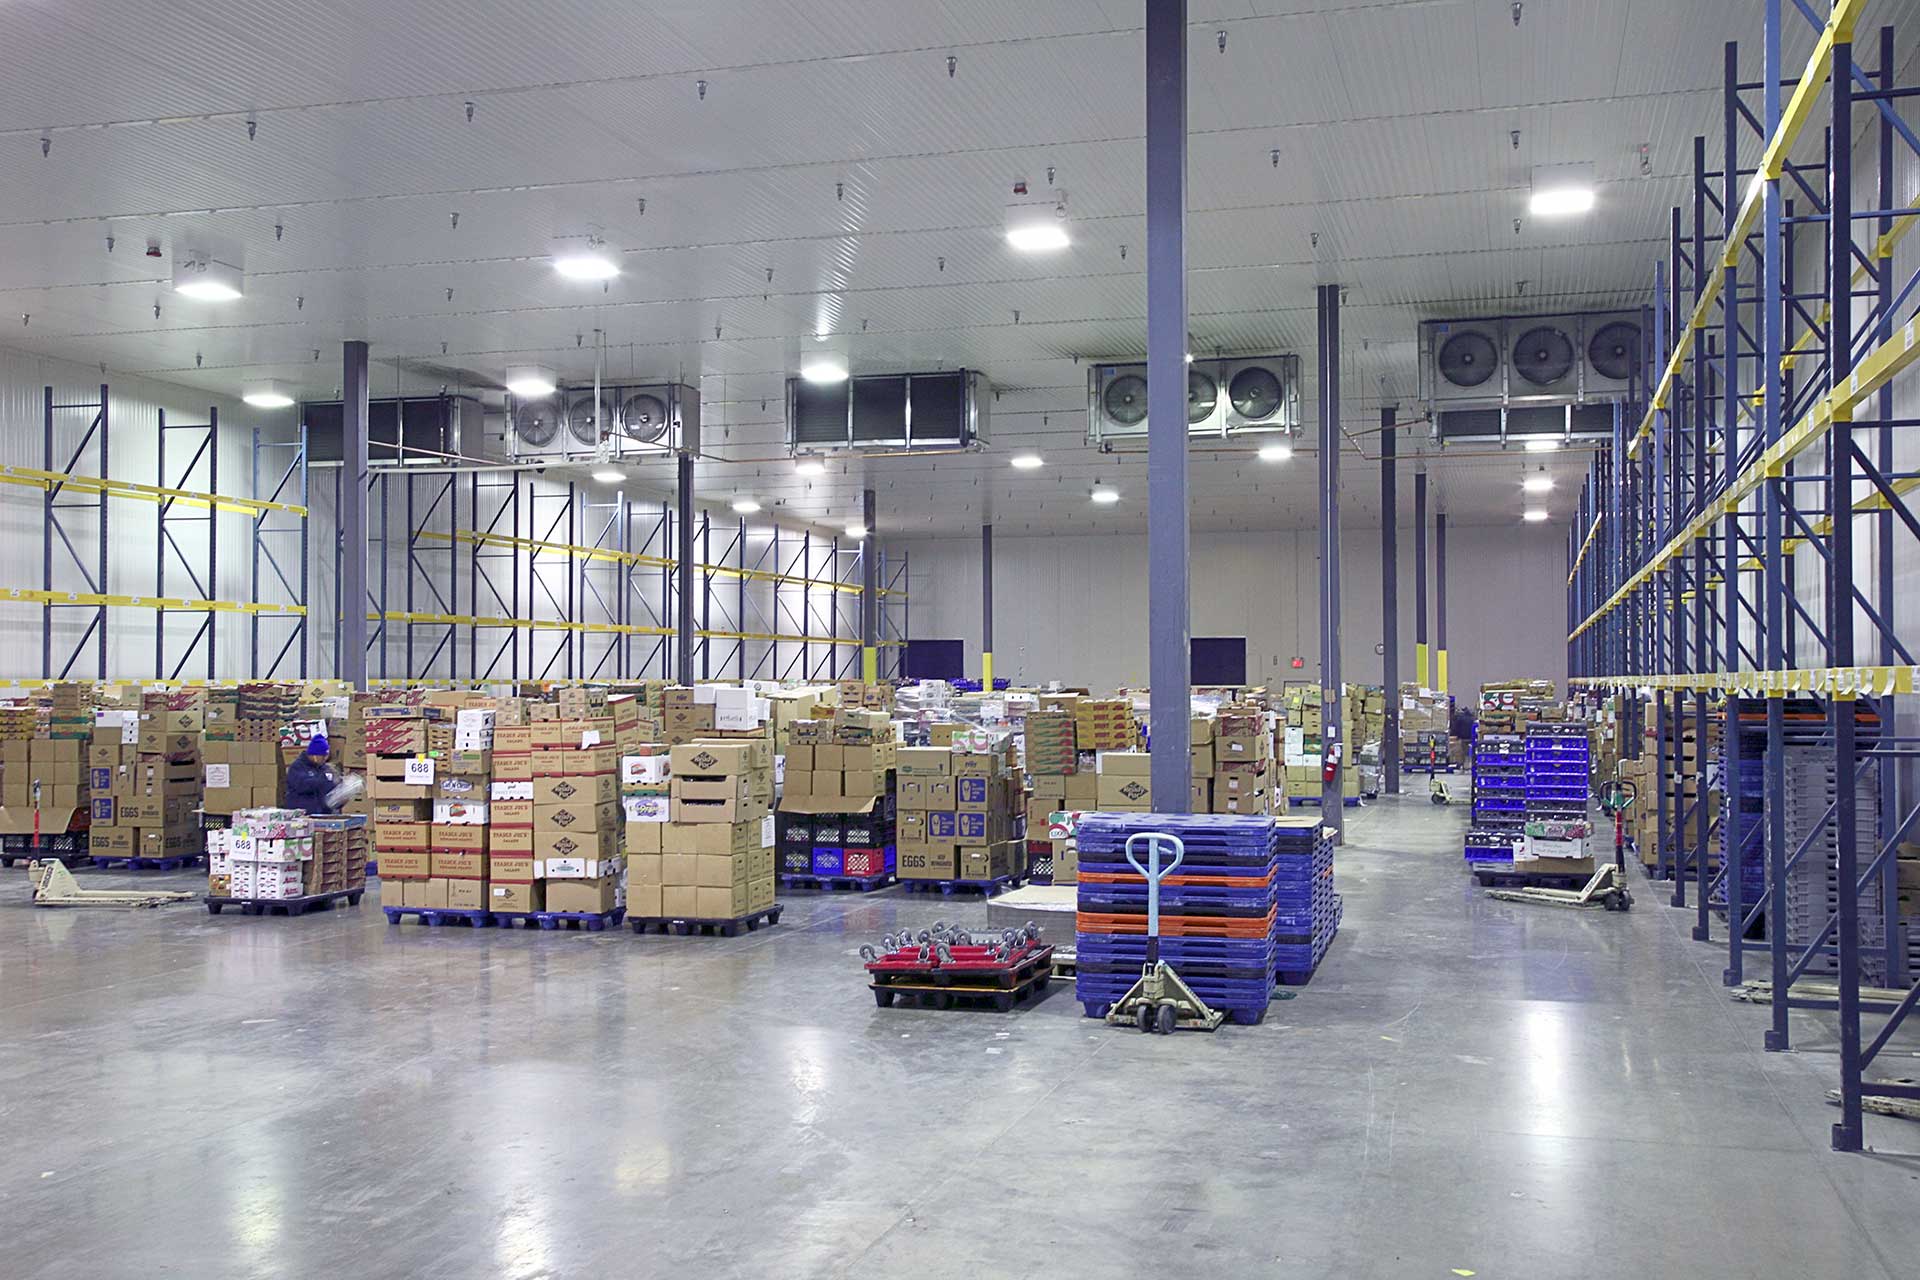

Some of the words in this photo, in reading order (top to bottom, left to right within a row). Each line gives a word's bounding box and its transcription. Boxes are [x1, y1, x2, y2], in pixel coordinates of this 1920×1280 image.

[411, 763, 429, 773] 688
[120, 806, 139, 818] EGGS
[92, 836, 110, 847] EGGS
[235, 839, 251, 850] 688
[902, 855, 926, 868] EGGS
